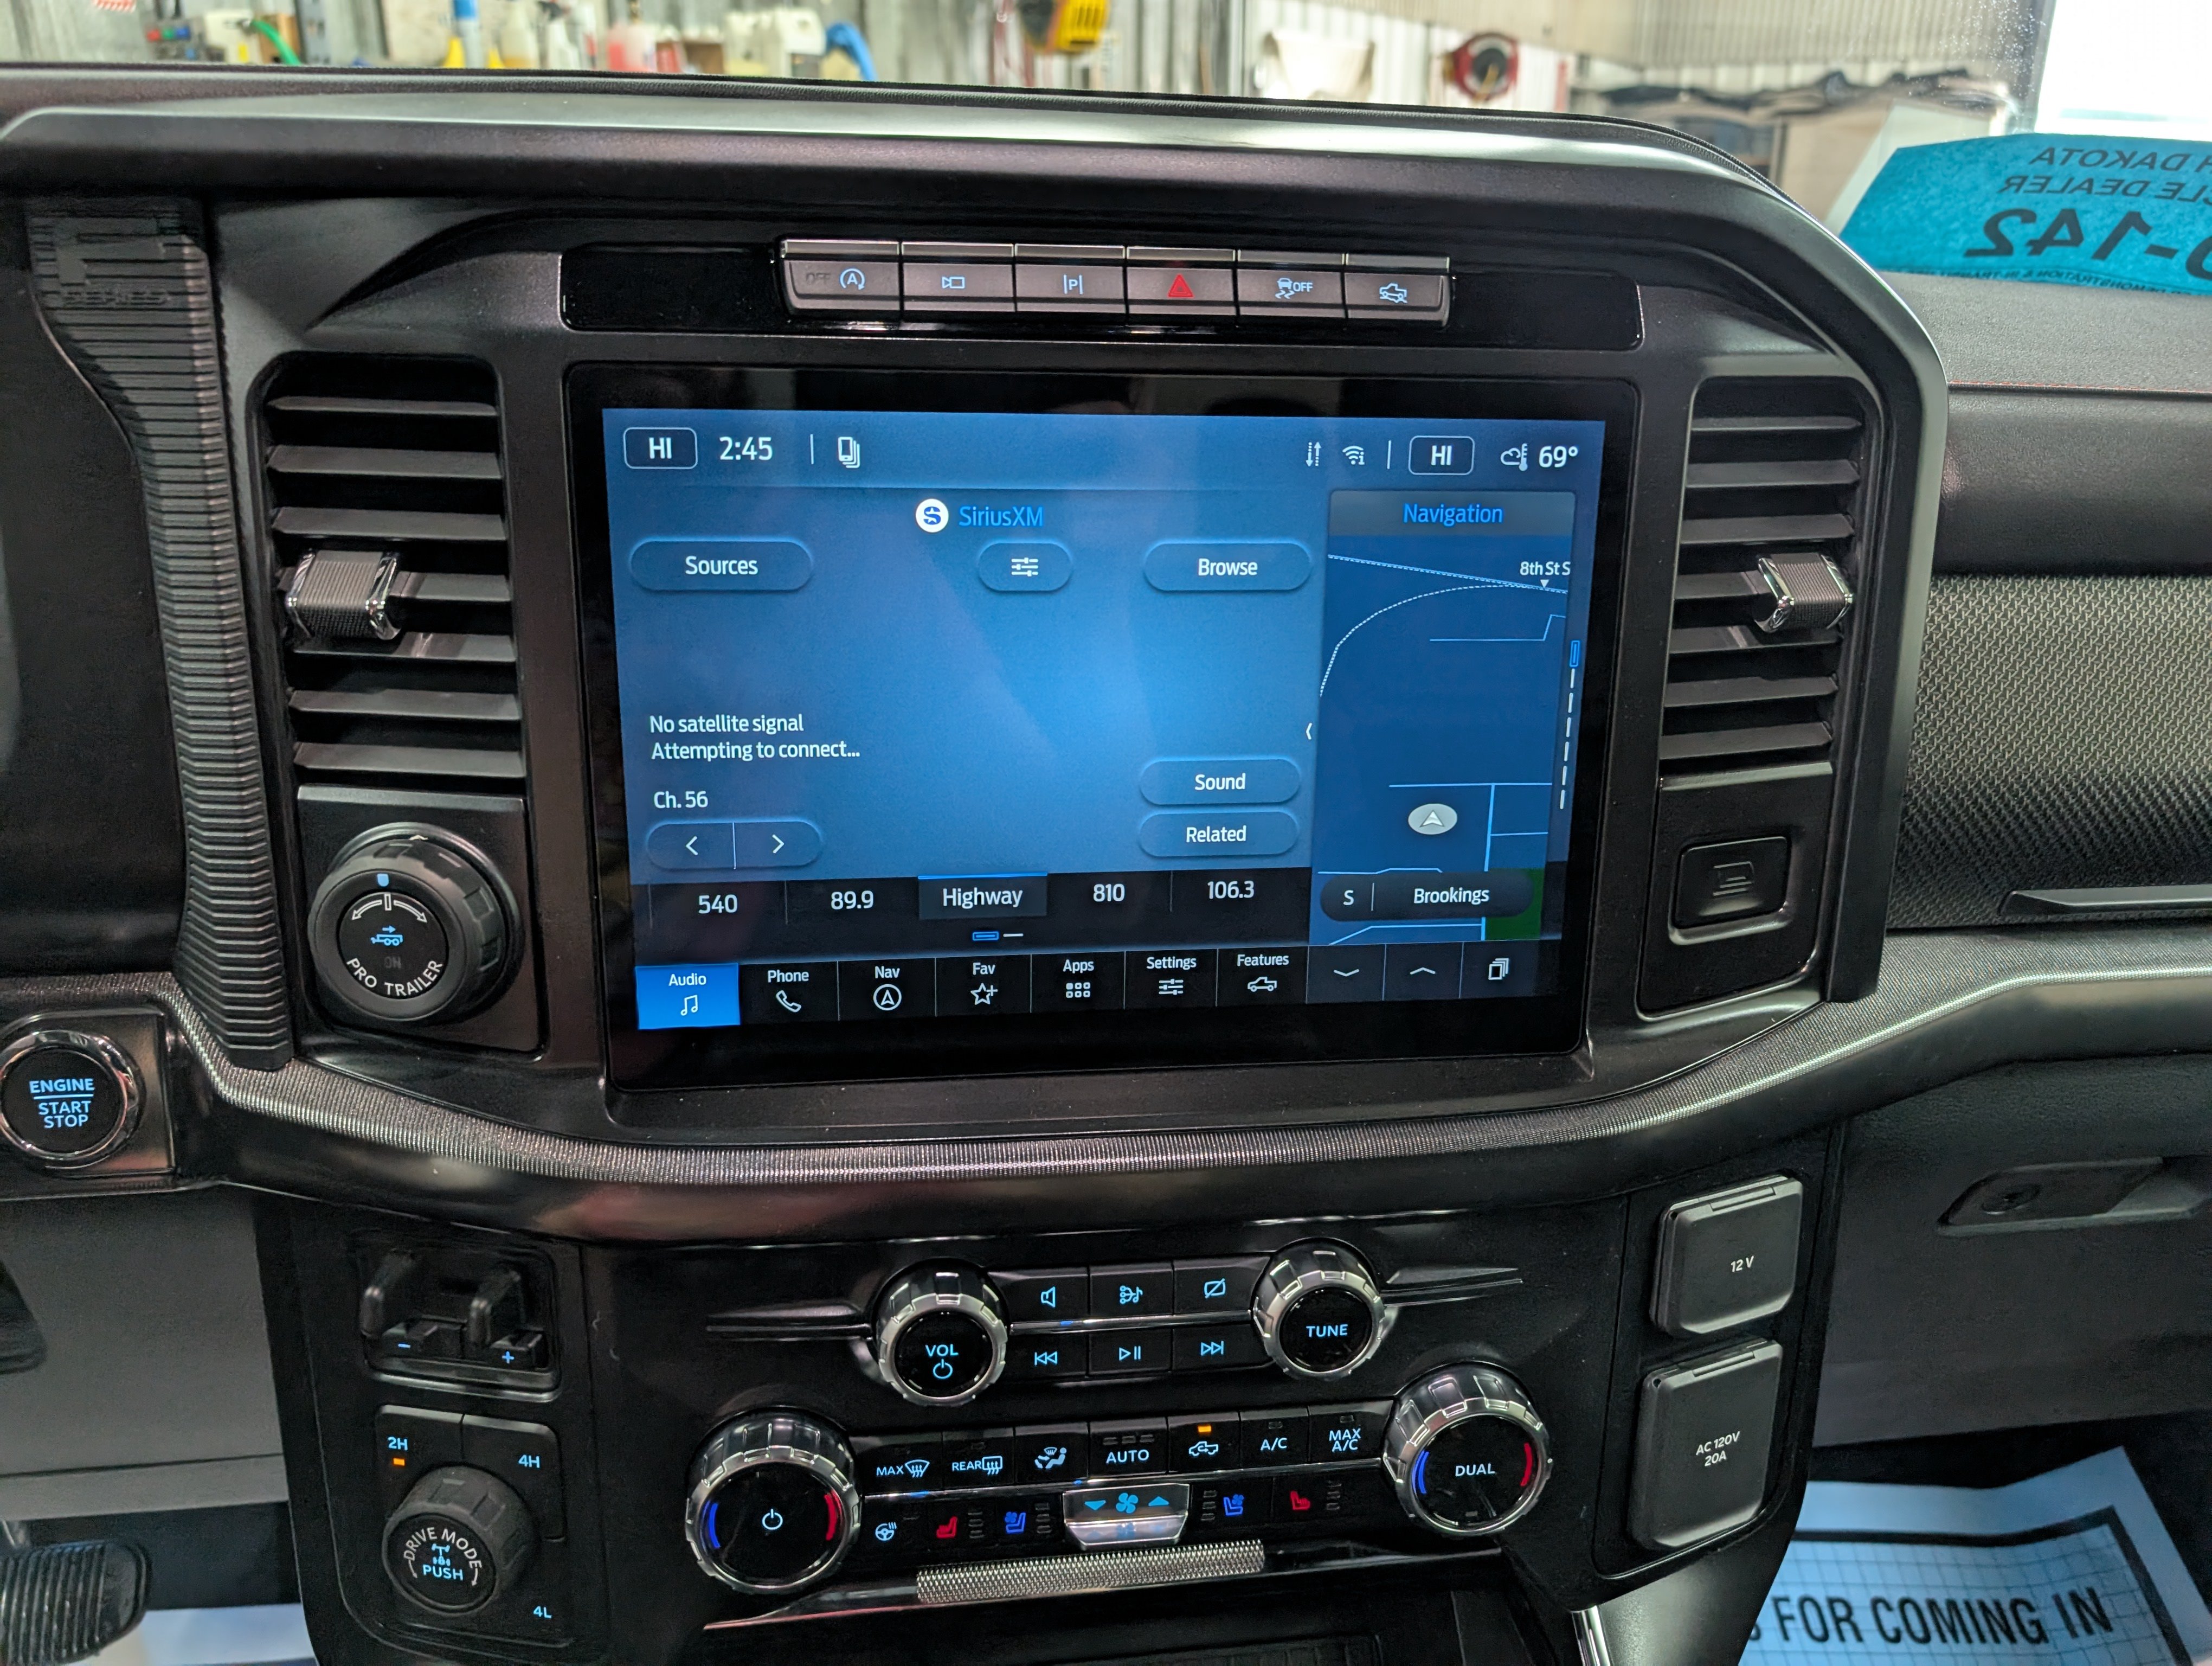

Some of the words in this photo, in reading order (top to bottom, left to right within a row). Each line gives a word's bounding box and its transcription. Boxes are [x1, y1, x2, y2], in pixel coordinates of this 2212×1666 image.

[1293, 282, 1314, 293] OFF
[649, 437, 672, 459] HI
[719, 437, 773, 460] 2:45
[1431, 445, 1452, 465] HI
[1538, 446, 1579, 468] 69°
[959, 505, 1044, 527] SiriusXM
[1403, 503, 1504, 527] Navigation
[685, 556, 758, 575] Sources
[1198, 558, 1258, 576] Browse
[1519, 561, 1542, 576] 8th
[1545, 561, 1559, 576] St
[1562, 561, 1571, 576] S
[650, 715, 675, 733] No
[678, 715, 749, 733] satellite
[752, 714, 804, 735] signal
[651, 742, 753, 762] Attempting
[756, 742, 775, 758] to
[779, 740, 860, 758] connect...
[1194, 773, 1246, 791] Sound
[653, 791, 681, 808] Ch.
[685, 790, 709, 808] 56
[1185, 824, 1247, 843] Related
[942, 886, 1024, 910] Highway
[1092, 883, 1125, 902] 810
[1207, 880, 1255, 899] 106.3
[1343, 889, 1355, 906] S
[1413, 887, 1490, 906] Brookings
[697, 894, 738, 914] 540
[830, 890, 874, 909] 89.9
[1062, 958, 1095, 975] Apps
[1146, 956, 1197, 970] Settings
[1237, 953, 1289, 966] Features
[346, 958, 377, 989] PRO
[384, 960, 443, 997] TRAILER
[767, 970, 809, 983] Phone
[874, 965, 900, 978] Nav
[972, 962, 996, 976] Fav
[668, 973, 707, 986] Audio
[29, 1078, 95, 1094] ENGINE
[38, 1100, 92, 1116] START
[43, 1114, 88, 1129] STOP
[1730, 1259, 1744, 1273] 12
[1745, 1255, 1754, 1268] V
[1306, 1324, 1348, 1338] TUNE
[925, 1343, 959, 1357] VOL
[1329, 1427, 1361, 1441] MAX
[387, 1436, 408, 1451] 2H
[1260, 1437, 1288, 1451] A/C
[1332, 1439, 1359, 1452] A/C
[1695, 1441, 1712, 1456] AC
[1713, 1431, 1741, 1449] 120V
[518, 1454, 541, 1469] 4H
[1105, 1449, 1150, 1464] AUTO
[1704, 1450, 1727, 1467] 20A
[876, 1465, 904, 1477] MAX
[951, 1461, 982, 1472] REAR
[1455, 1463, 1496, 1477] DUAL
[403, 1527, 438, 1561] DRIVE
[441, 1528, 483, 1569] MODE
[422, 1564, 464, 1581] PUSH
[532, 1605, 552, 1619] 4L
[1771, 1595, 1863, 1643] FOR
[1870, 1595, 2050, 1646] COMING
[2053, 1586, 2114, 1639] IN
